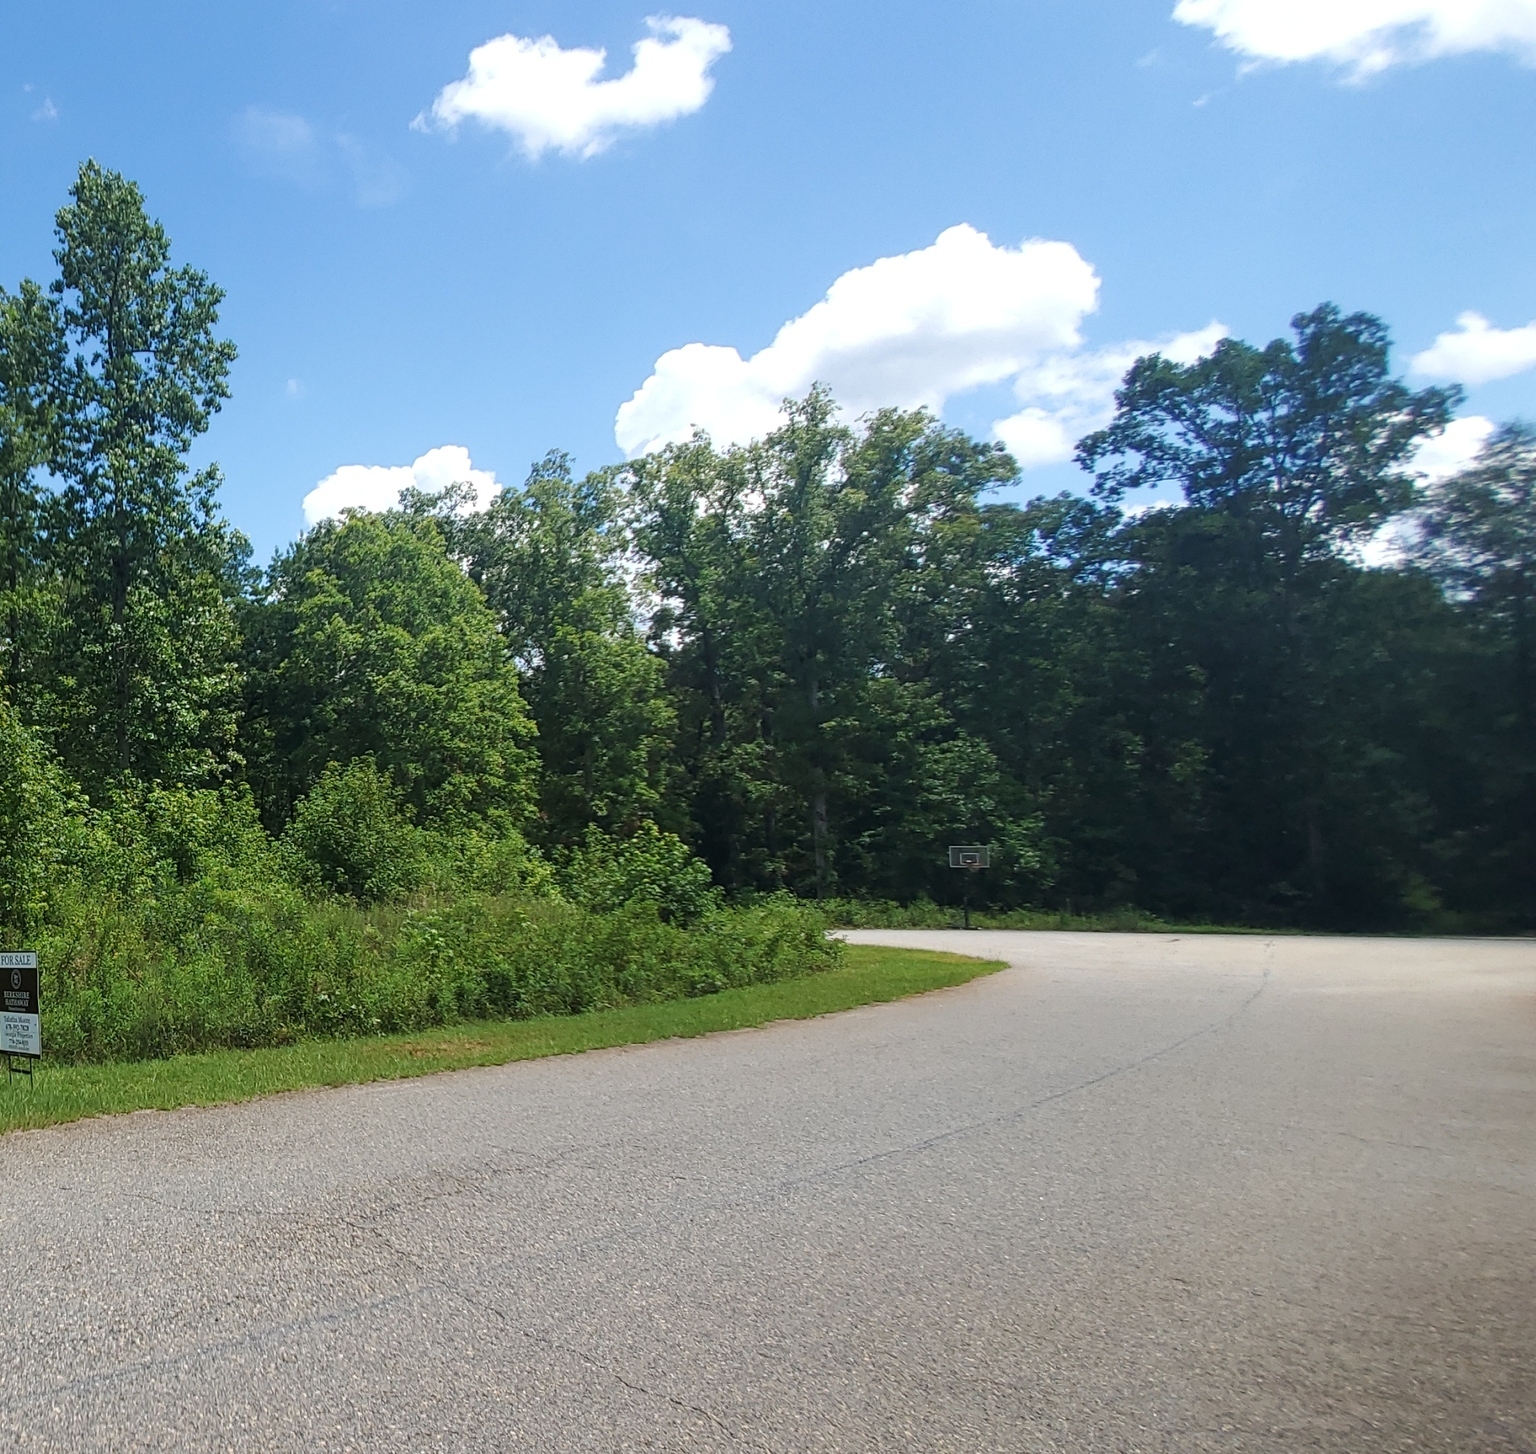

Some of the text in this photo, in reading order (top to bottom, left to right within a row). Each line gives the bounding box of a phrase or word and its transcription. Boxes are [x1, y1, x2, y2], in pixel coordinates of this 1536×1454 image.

[1, 955, 31, 965] FOR SALE
[4, 991, 30, 999] BERKSHIRE
